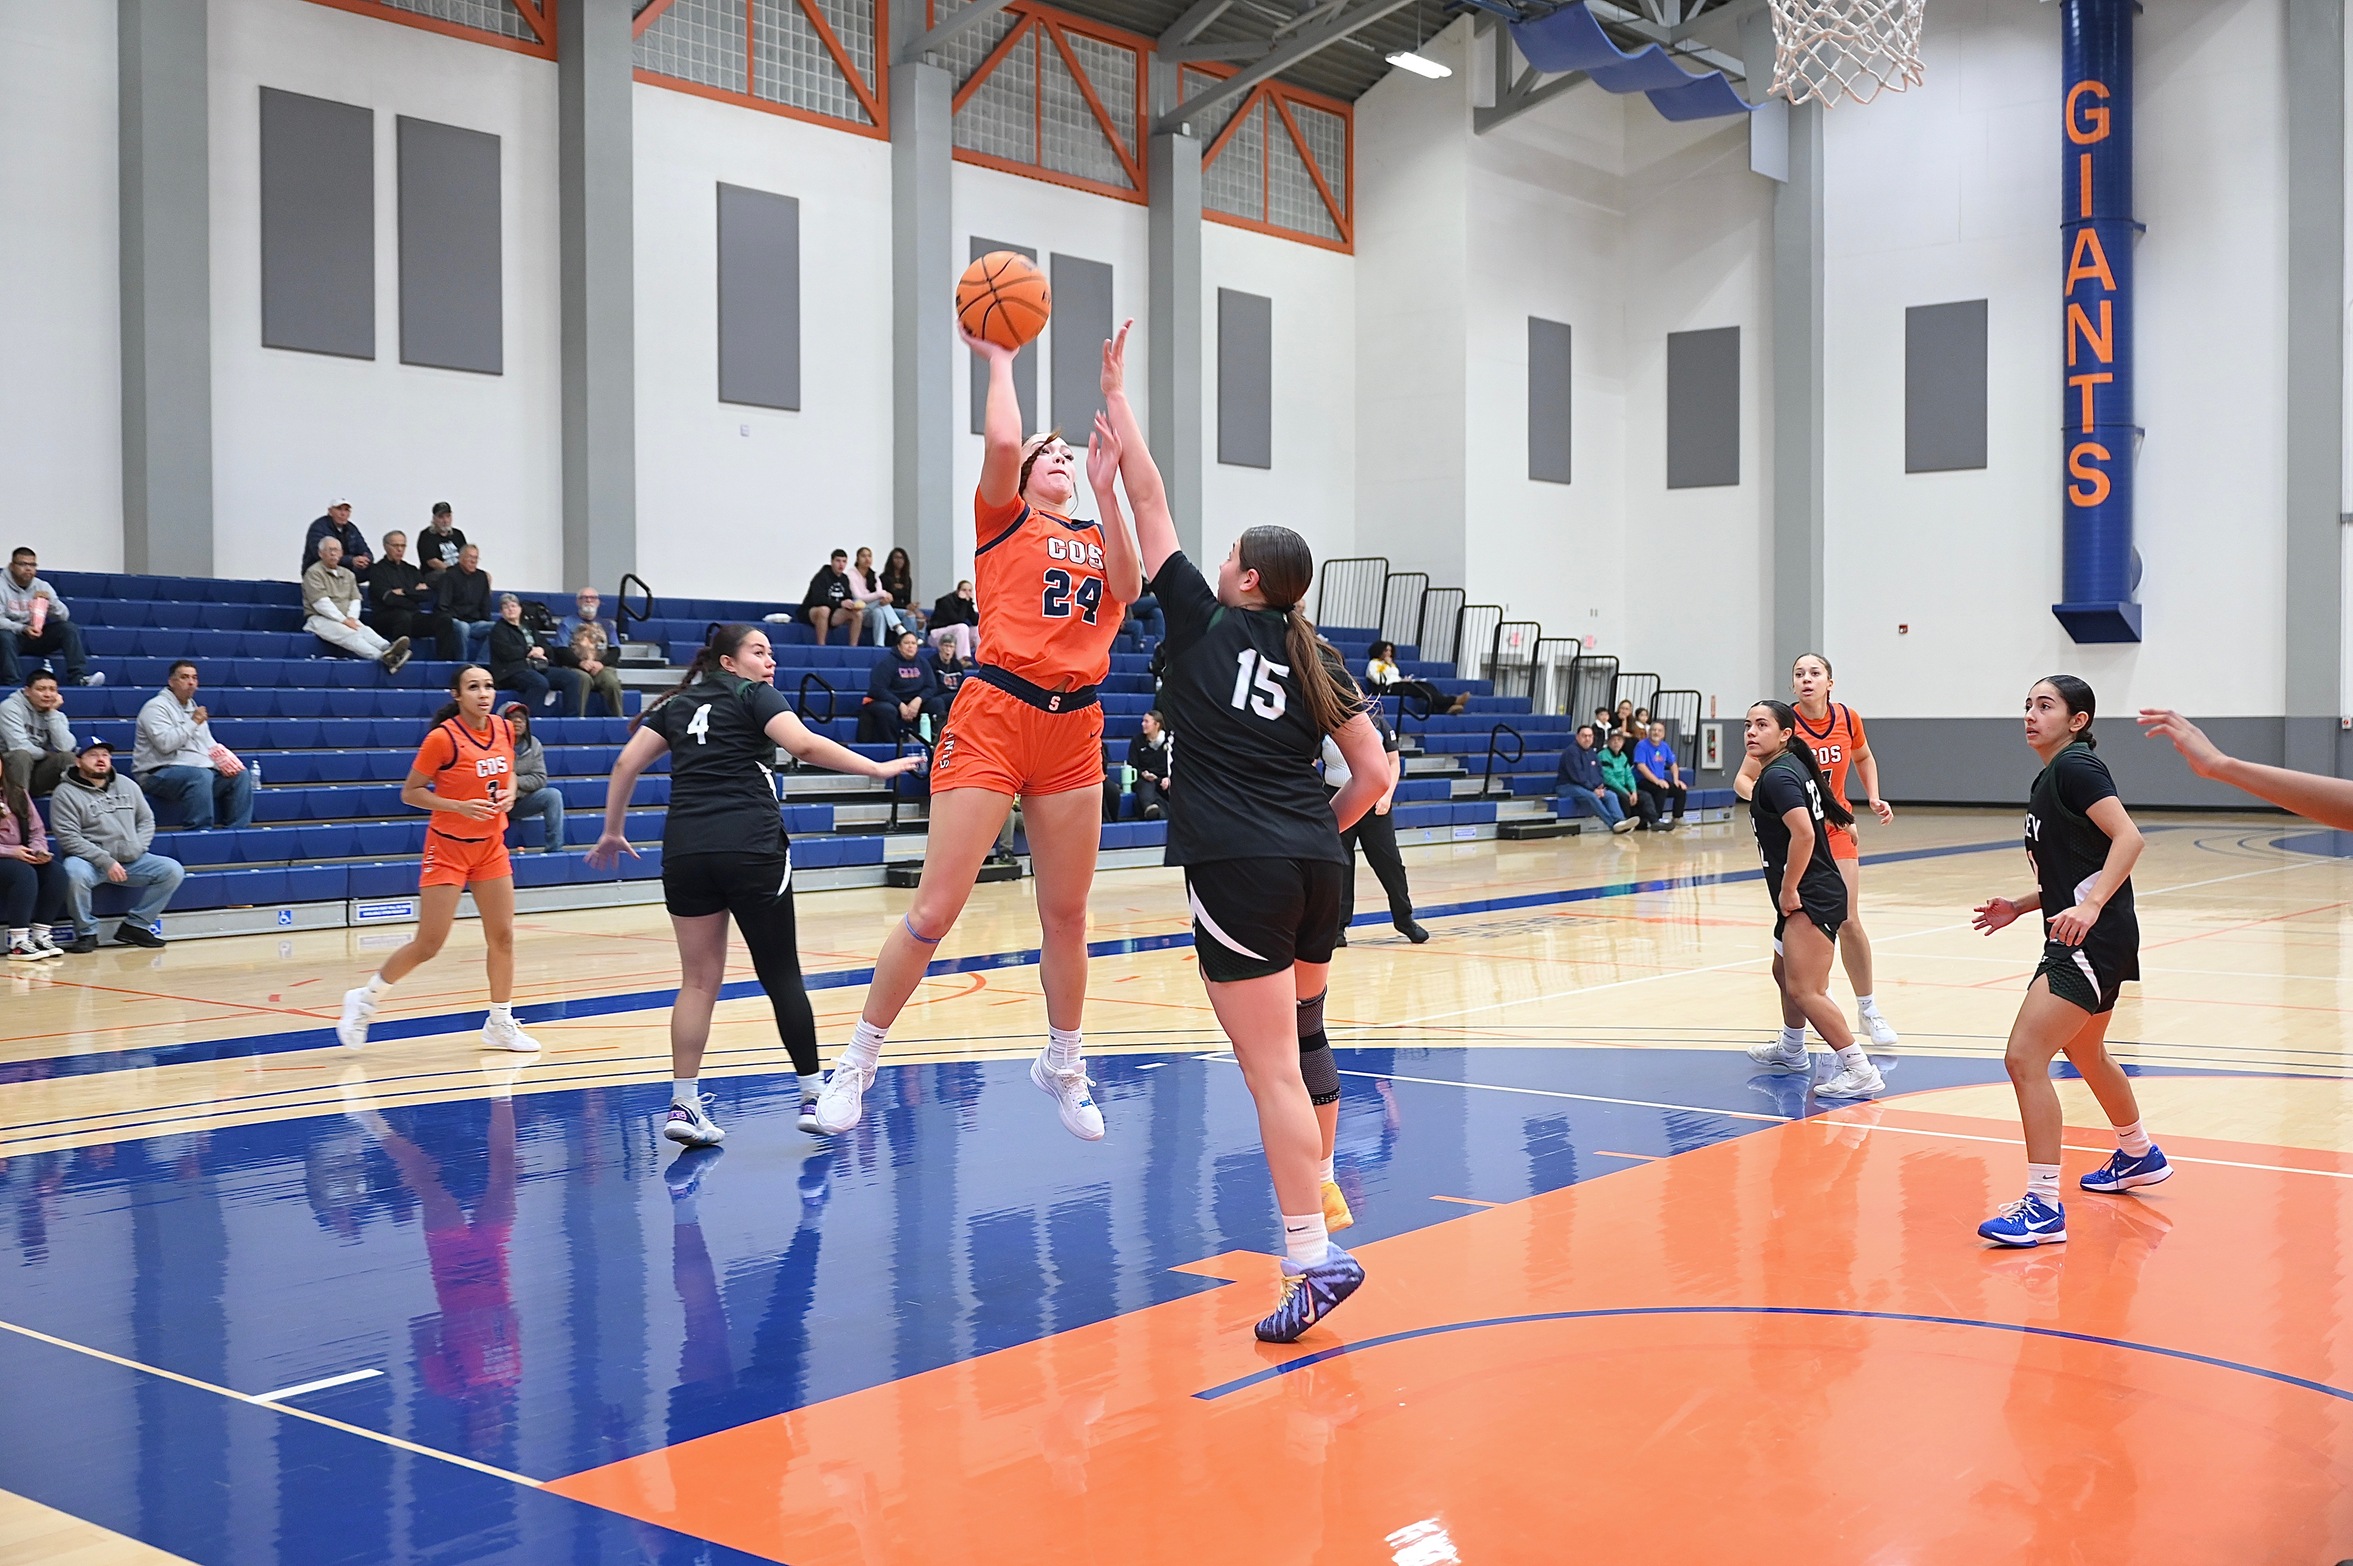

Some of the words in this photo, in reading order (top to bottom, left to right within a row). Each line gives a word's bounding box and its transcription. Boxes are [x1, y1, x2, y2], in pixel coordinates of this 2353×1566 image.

[2064, 80, 2117, 508] GIANTS
[1047, 536, 1104, 570] COS
[1042, 567, 1103, 626] 24
[1048, 695, 1061, 711] S
[1231, 648, 1290, 720] 15
[686, 703, 712, 745] 4
[475, 755, 508, 777] COS
